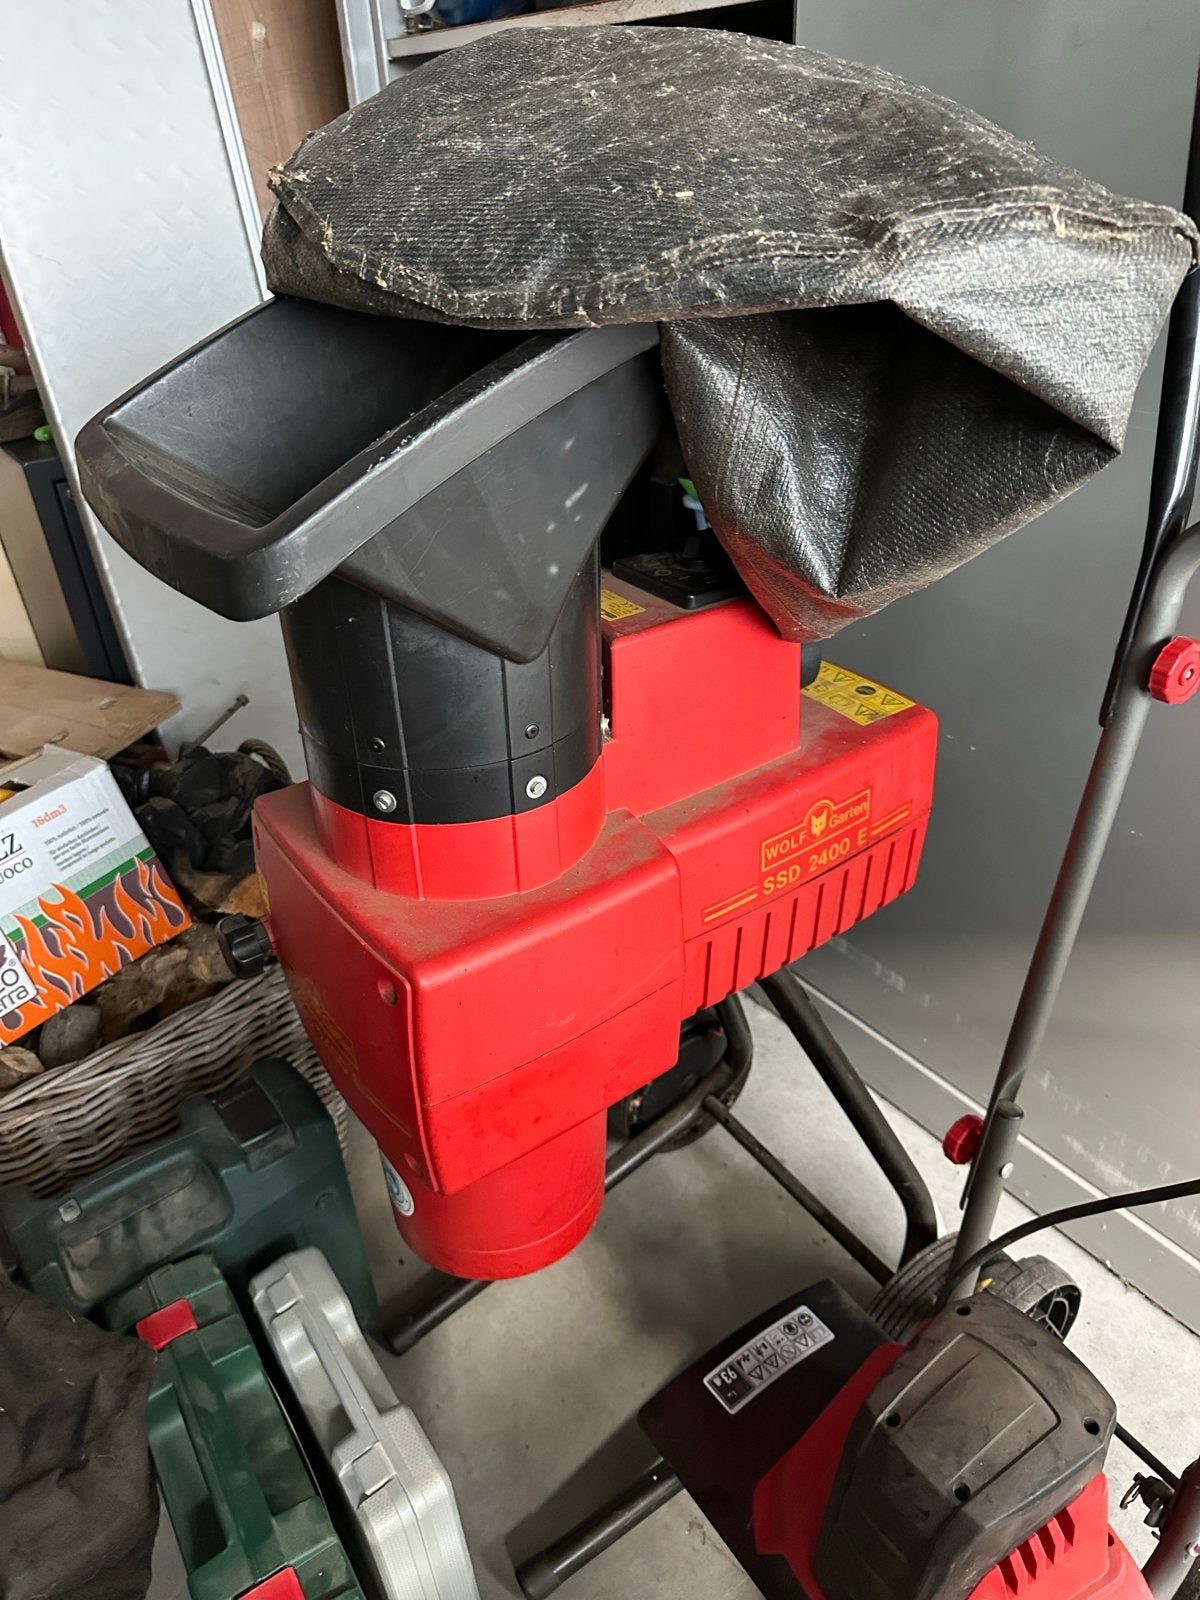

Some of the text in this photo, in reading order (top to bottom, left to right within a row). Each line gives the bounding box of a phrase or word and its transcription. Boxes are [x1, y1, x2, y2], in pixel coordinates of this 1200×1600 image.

[763, 827, 868, 895] SSD 2400 E
[766, 801, 868, 861] WOLF Garten
